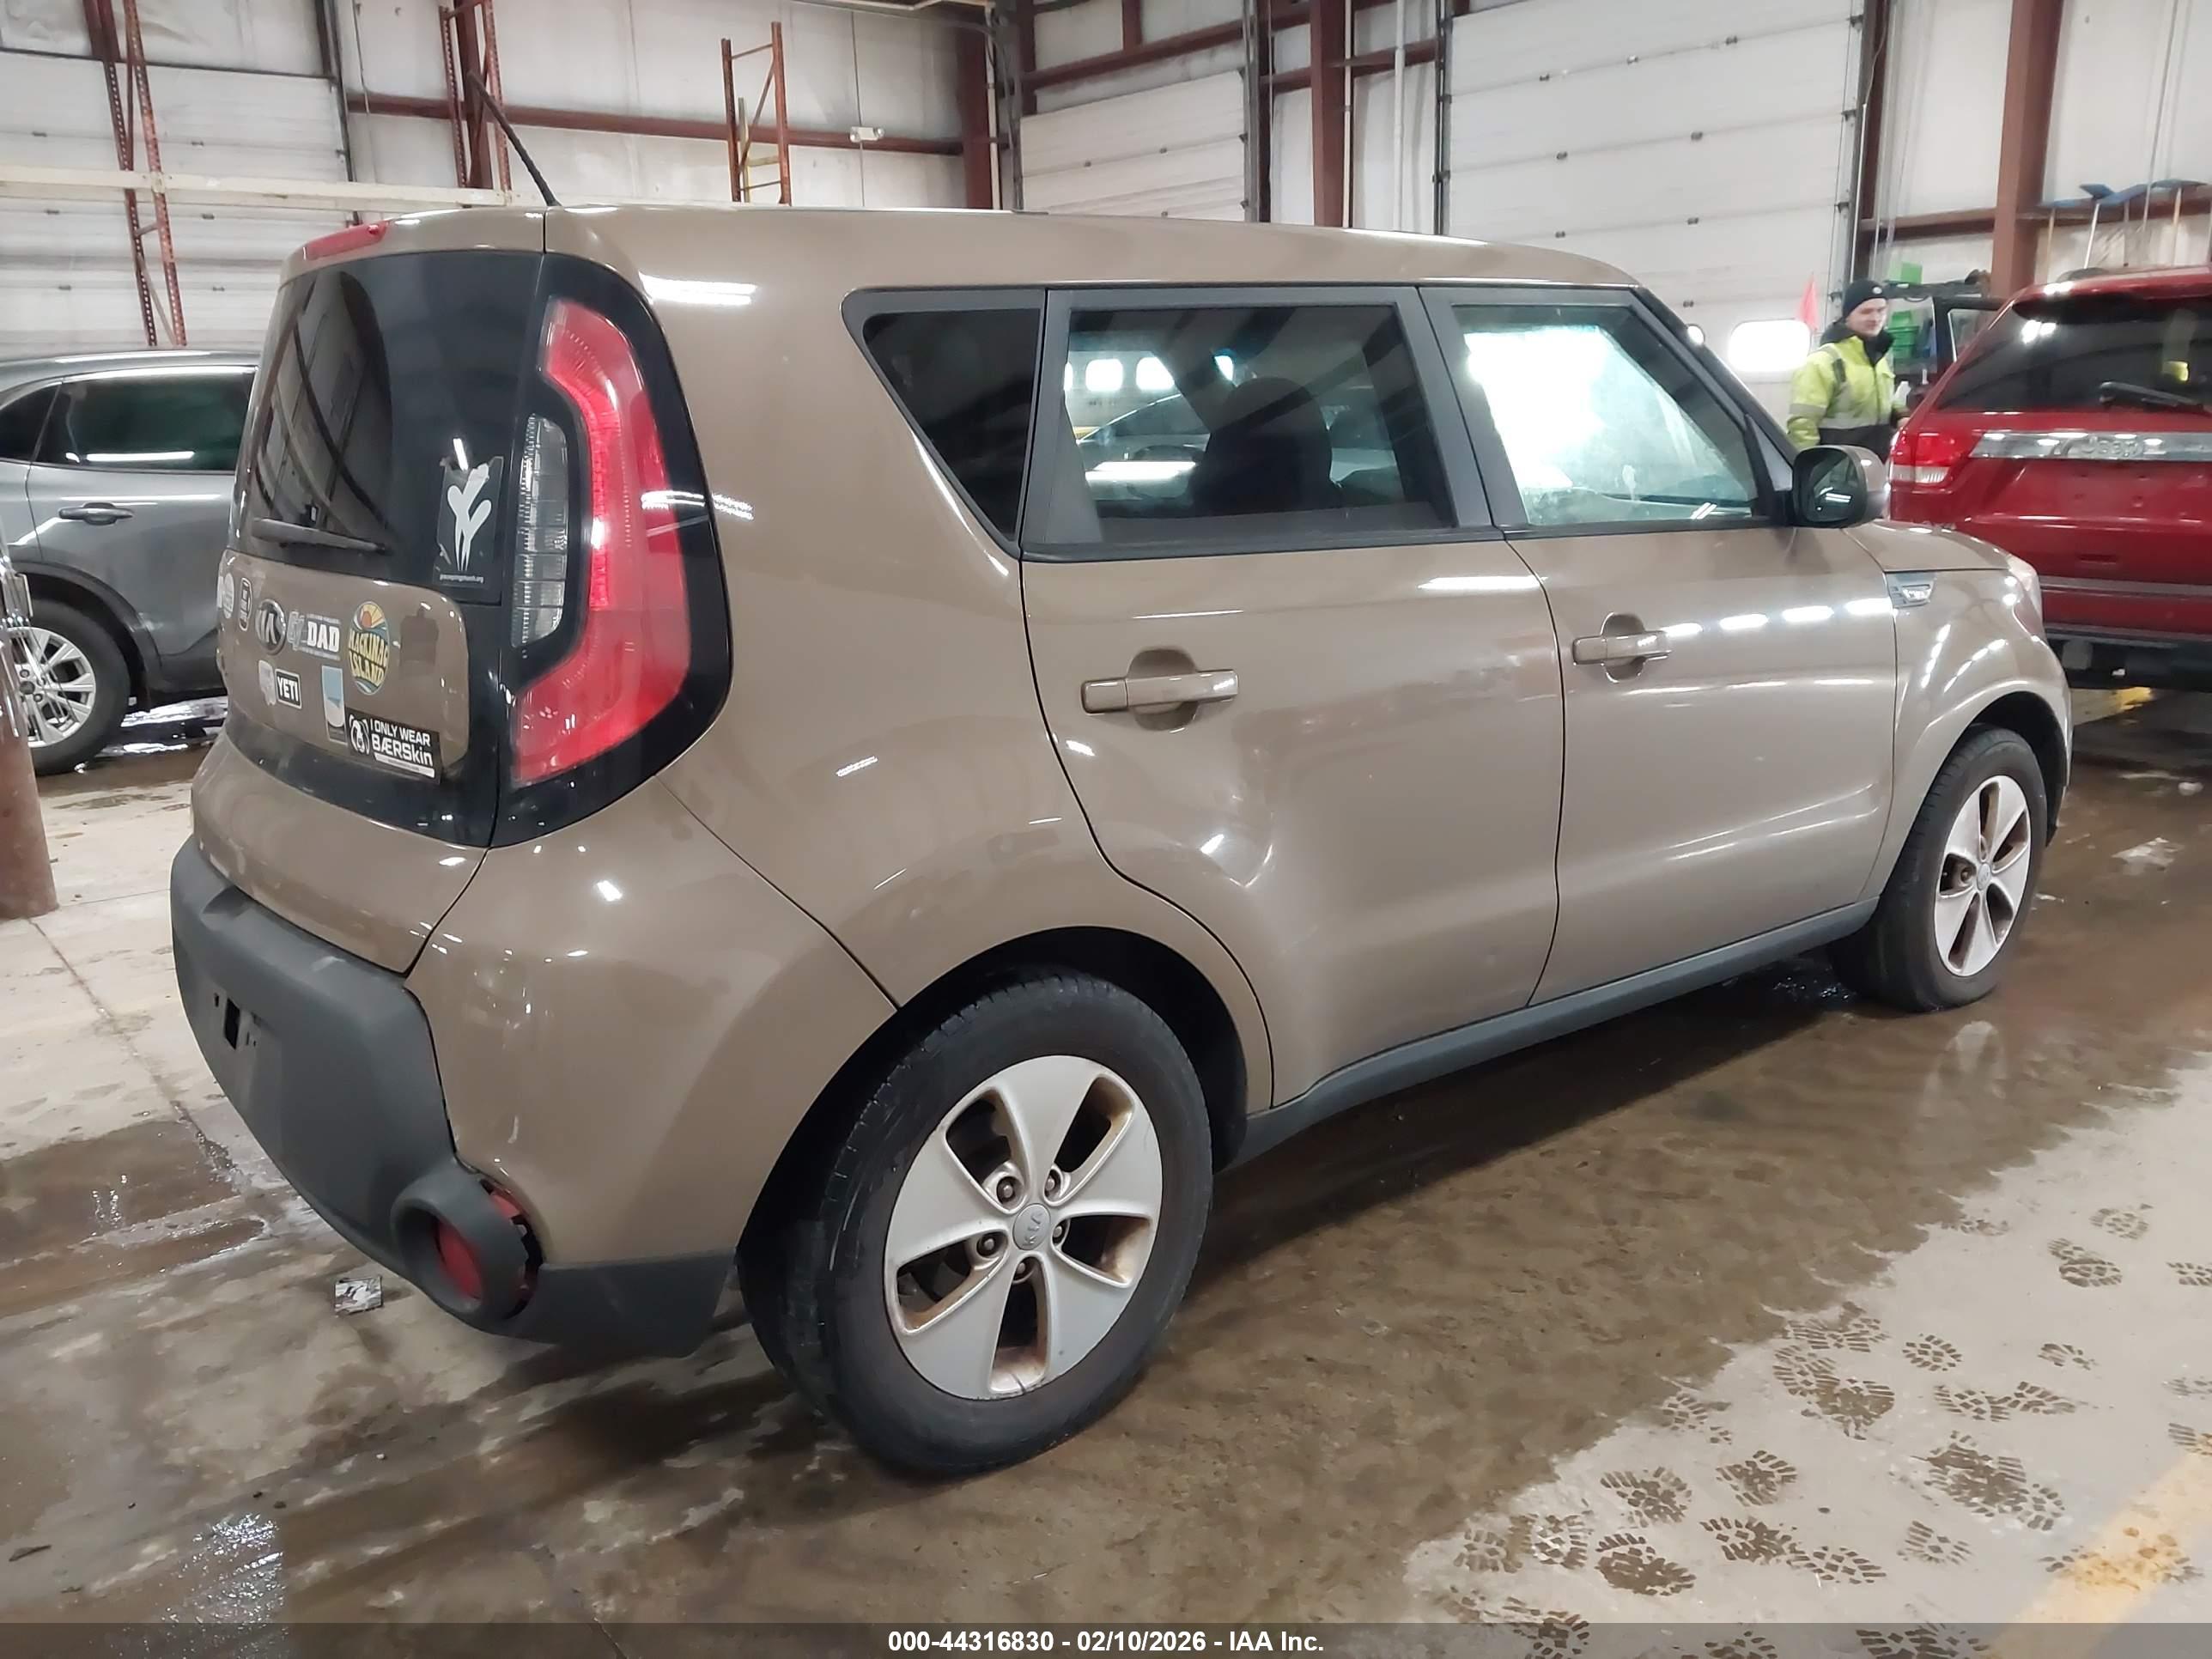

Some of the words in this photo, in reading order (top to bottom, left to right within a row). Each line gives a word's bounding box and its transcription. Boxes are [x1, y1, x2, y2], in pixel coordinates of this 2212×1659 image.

[307, 620, 340, 653] DAD
[349, 650, 386, 687] ISLAND
[276, 675, 299, 702] YETI
[369, 718, 374, 732] I
[374, 720, 398, 738] ONLY
[398, 726, 431, 747] WEAR
